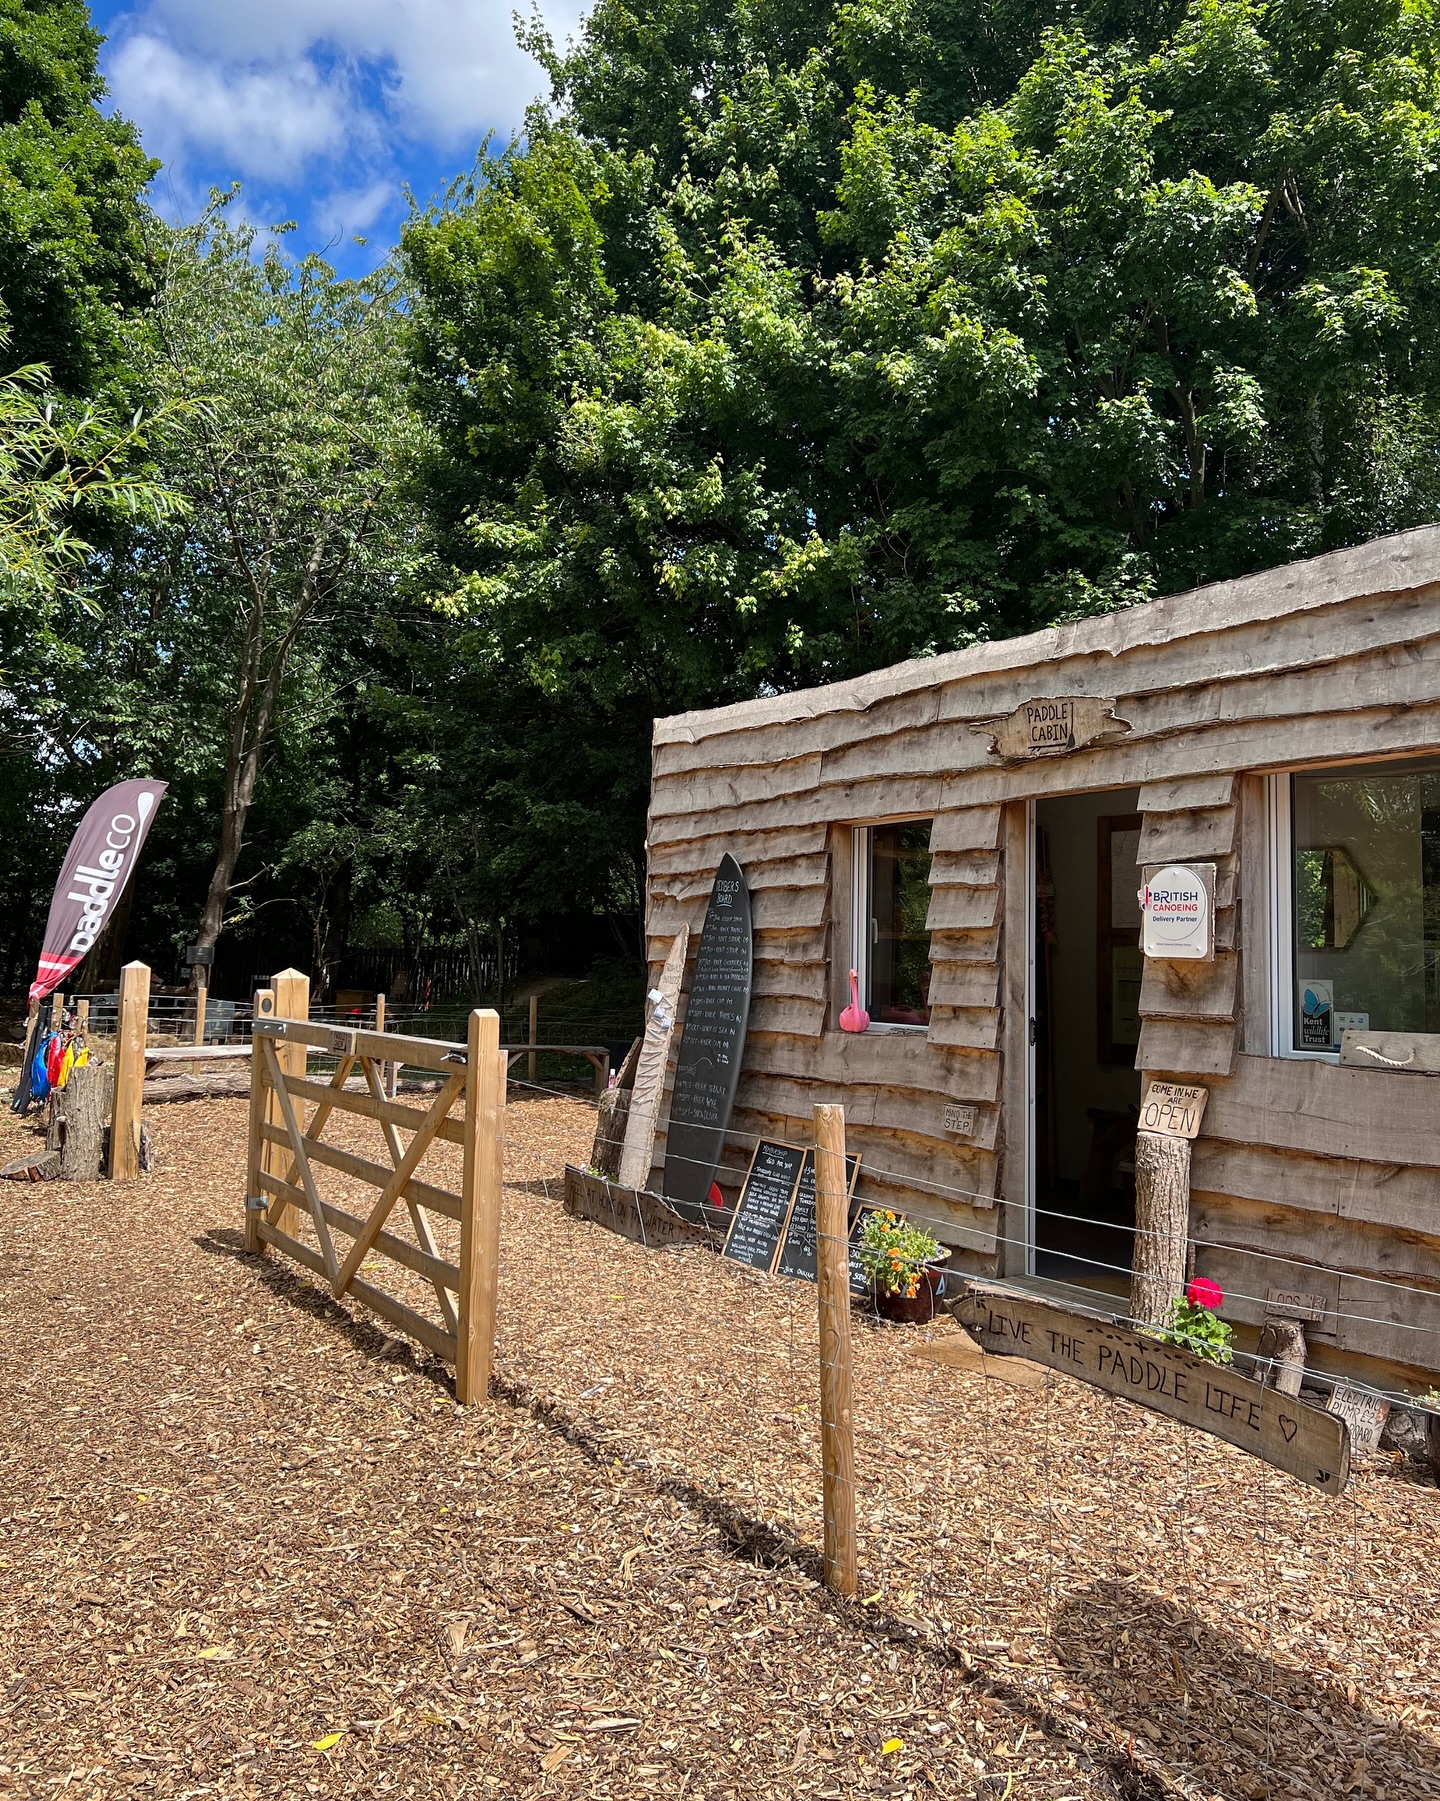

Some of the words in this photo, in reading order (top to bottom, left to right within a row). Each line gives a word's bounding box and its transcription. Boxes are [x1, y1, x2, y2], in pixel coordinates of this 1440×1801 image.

[1027, 703, 1068, 723] PADDLE
[1031, 723, 1068, 742] CABIN
[716, 893, 732, 904] BOARD
[1153, 891, 1198, 904] BRITISH
[1153, 904, 1198, 912] CANOEING
[1152, 915, 1175, 923] Delivery
[1303, 1017, 1323, 1025] Kent
[1304, 1025, 1330, 1036] wildlife
[1304, 1035, 1326, 1043] Trust
[1151, 1084, 1173, 1096] COME
[945, 1108, 960, 1118] MIND
[962, 1111, 973, 1120] THE
[1145, 1102, 1195, 1132] OPEN
[944, 1118, 970, 1130] STEP
[645, 1212, 675, 1238] WATER
[1269, 1291, 1301, 1312] LOOS
[988, 1310, 1032, 1346] LIVE
[1046, 1329, 1085, 1365] THE
[1098, 1345, 1189, 1405] PADDLE
[1204, 1382, 1261, 1432] LIFE
[1335, 1387, 1381, 1411] ELECTRIC
[1332, 1402, 1360, 1419] PUMP
